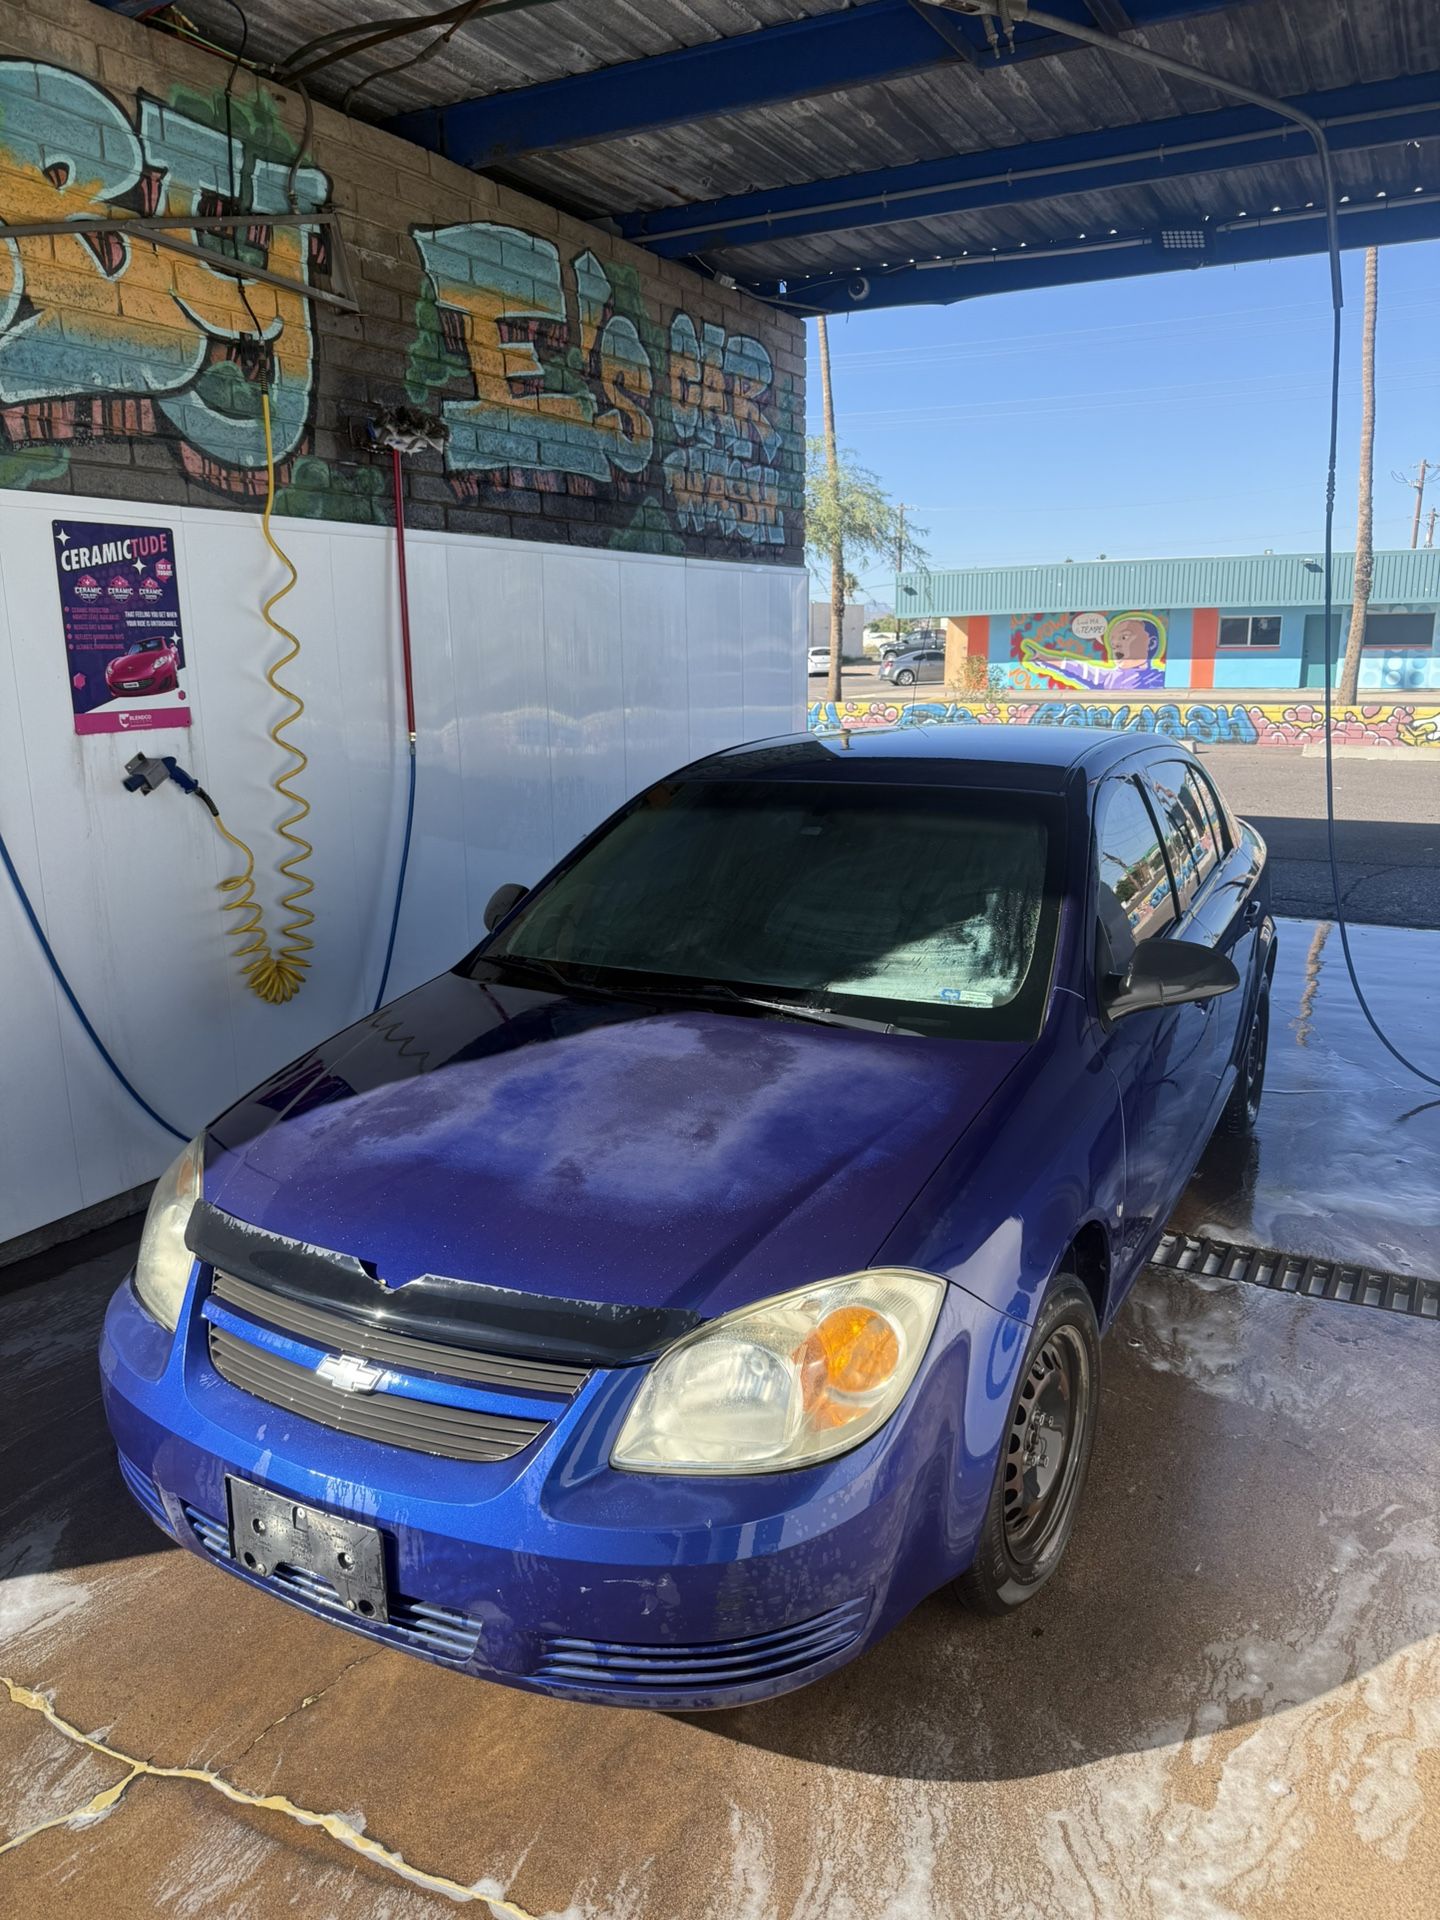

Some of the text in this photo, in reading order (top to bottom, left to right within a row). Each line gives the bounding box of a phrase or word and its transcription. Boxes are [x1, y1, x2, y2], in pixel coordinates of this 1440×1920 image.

[670, 309, 783, 464] CAR
[662, 446, 786, 545] WASH
[61, 533, 167, 572] CERAMICTUDE
[74, 586, 102, 595] CERAMIC
[107, 586, 134, 596] CERAMIC
[139, 588, 163, 597] CERAMIC
